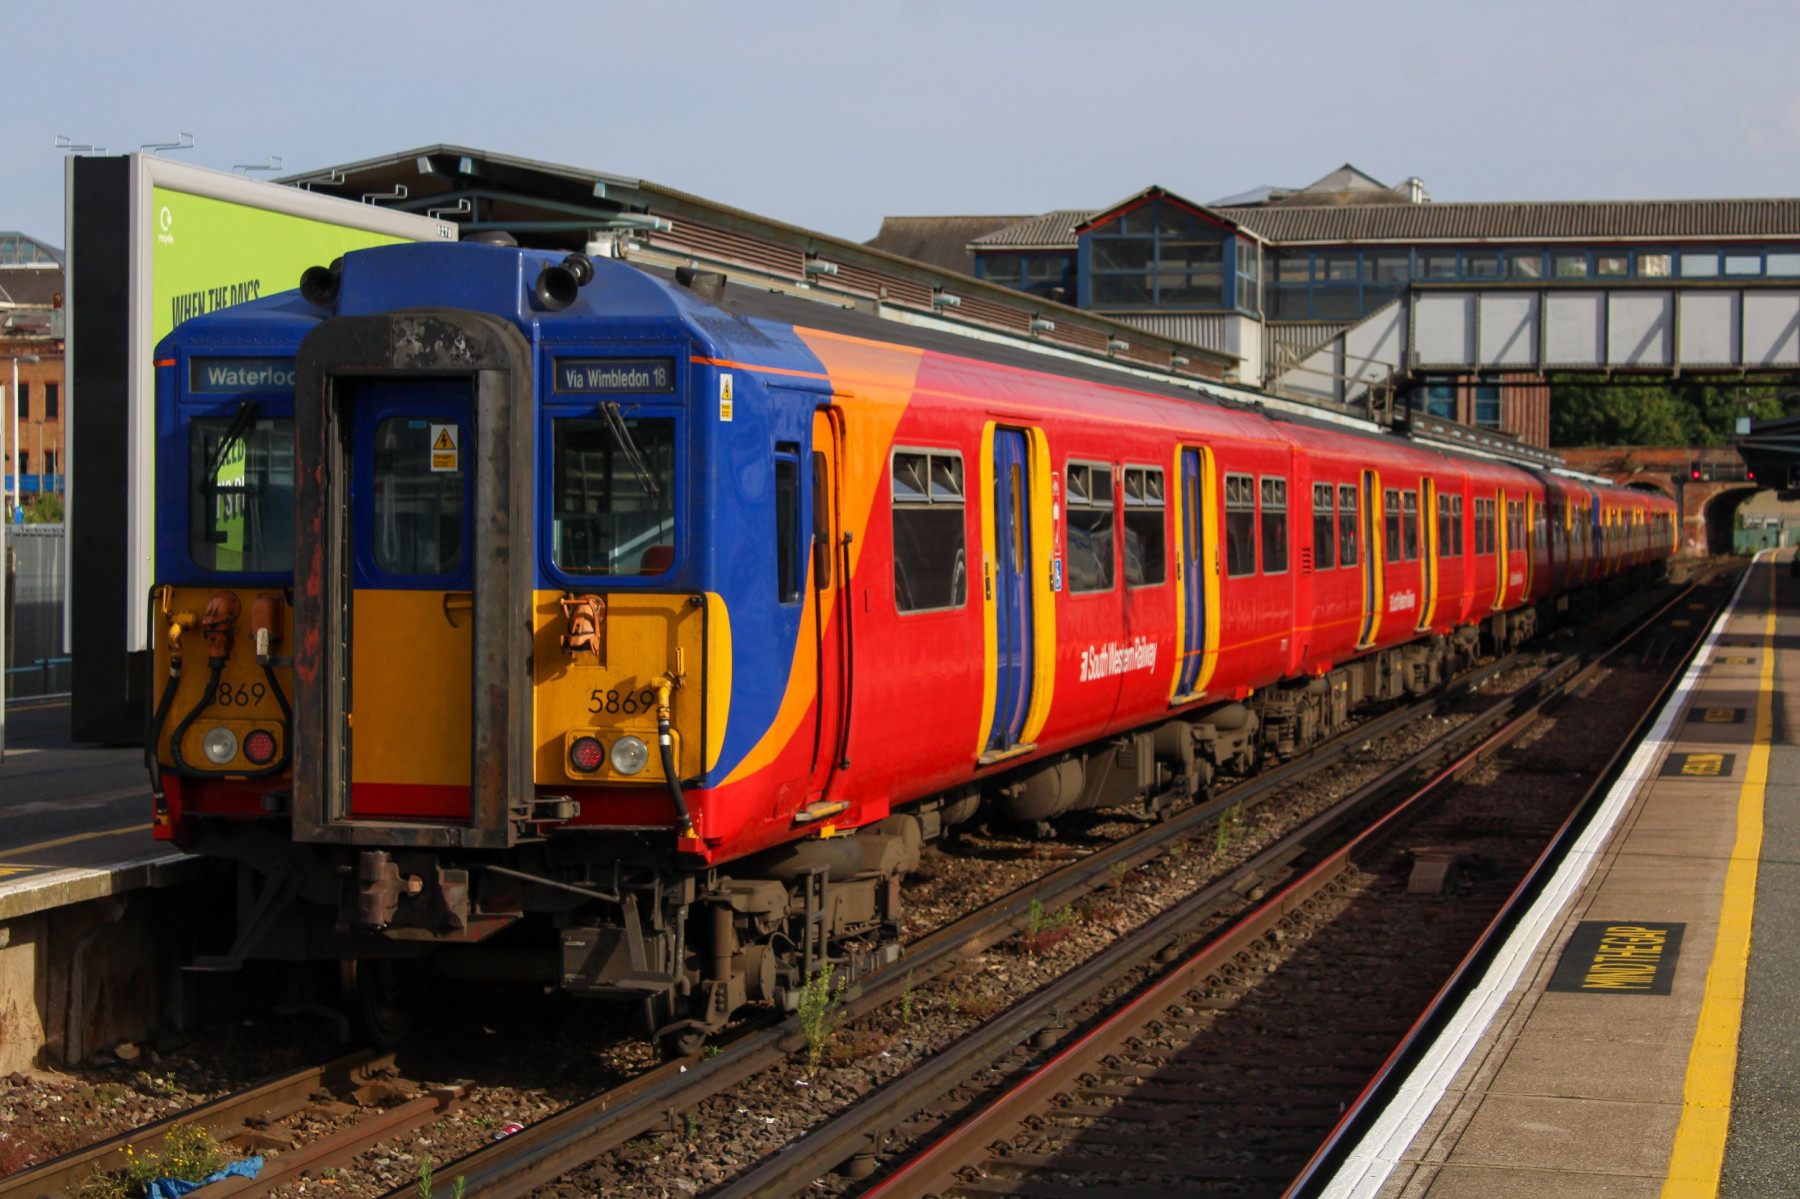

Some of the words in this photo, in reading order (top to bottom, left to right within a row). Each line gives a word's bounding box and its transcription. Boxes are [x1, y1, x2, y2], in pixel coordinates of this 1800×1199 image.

[172, 290, 206, 330] WHEN
[208, 286, 228, 312] THE
[566, 368, 584, 388] Via
[587, 368, 650, 388] Wimbledon
[652, 367, 667, 387] 18
[1087, 642, 1108, 681] South
[206, 681, 266, 707] 869
[588, 689, 655, 715] 5869
[1600, 926, 1668, 945] GAP
[1593, 944, 1663, 962] THE
[1581, 962, 1657, 989] MIND
